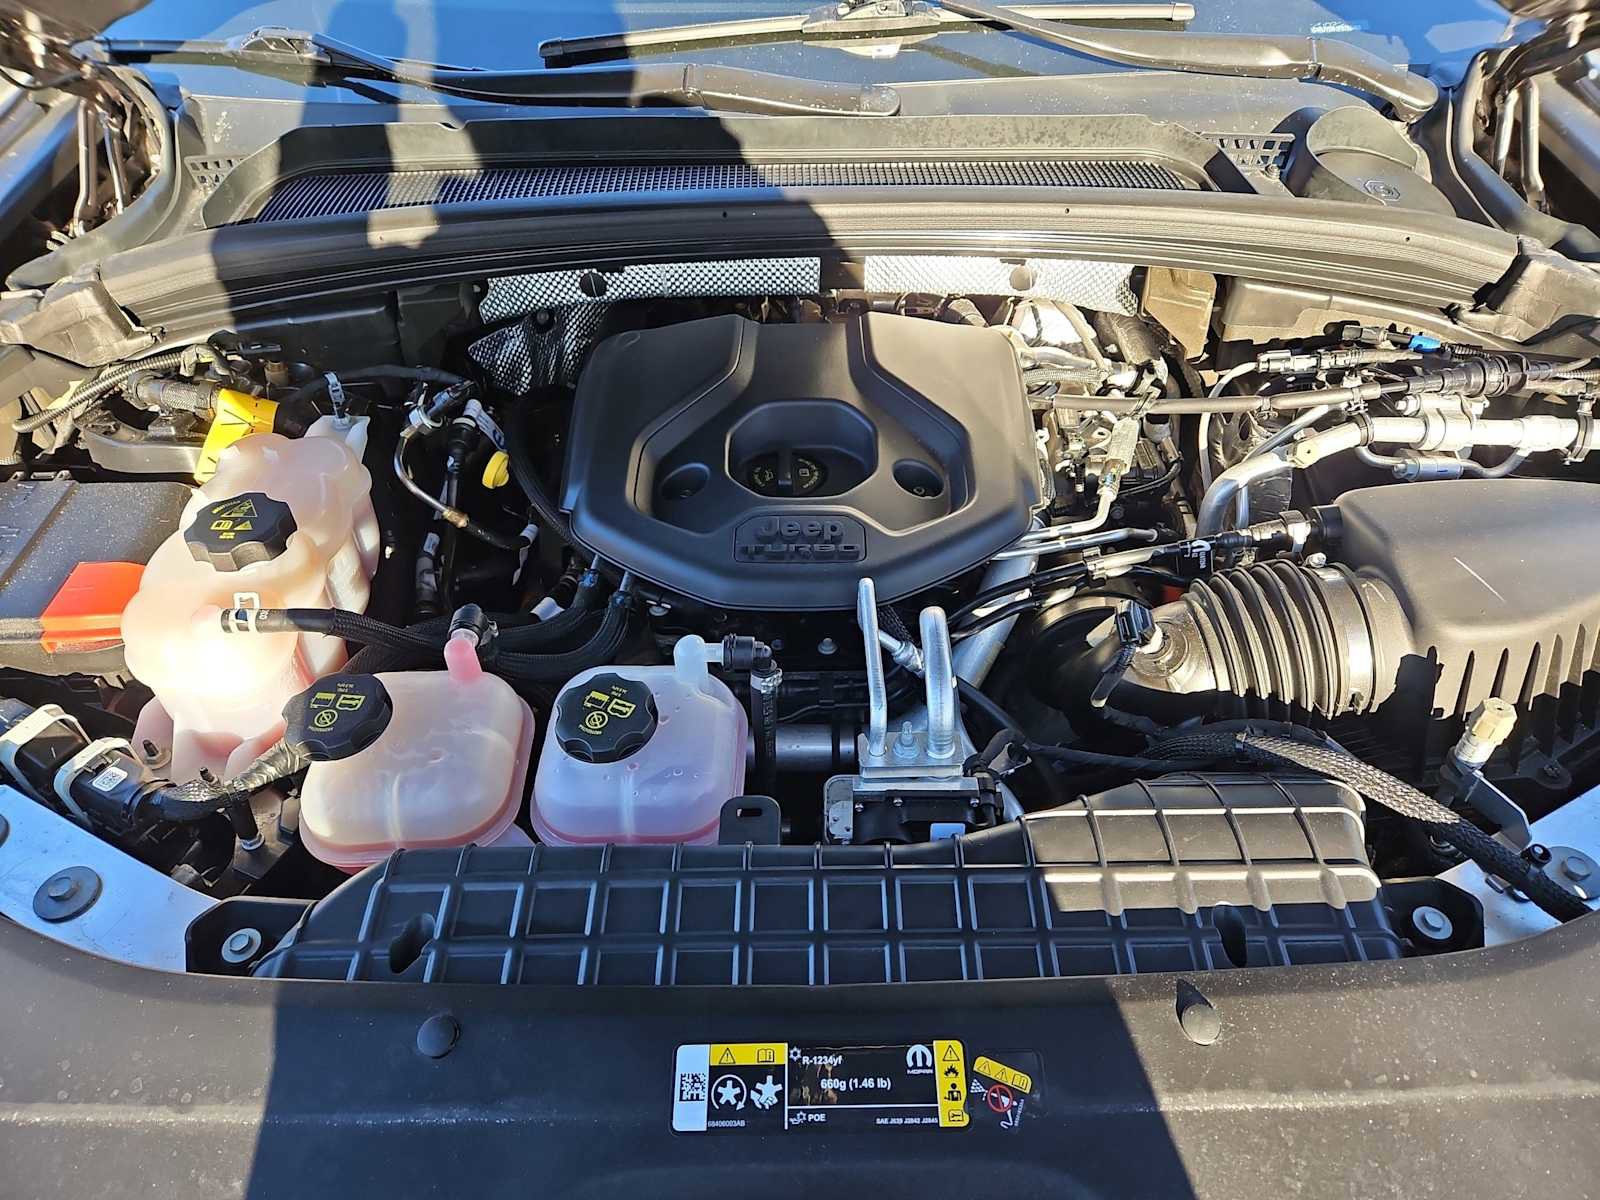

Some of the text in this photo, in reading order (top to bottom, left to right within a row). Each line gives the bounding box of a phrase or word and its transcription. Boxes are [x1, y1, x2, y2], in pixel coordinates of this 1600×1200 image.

[756, 516, 845, 541] Jeep
[742, 543, 861, 559] TURBO
[802, 1055, 843, 1067] R-1234yf
[820, 1078, 892, 1091] 660g (1.46 lb)
[808, 1113, 826, 1123] POE
